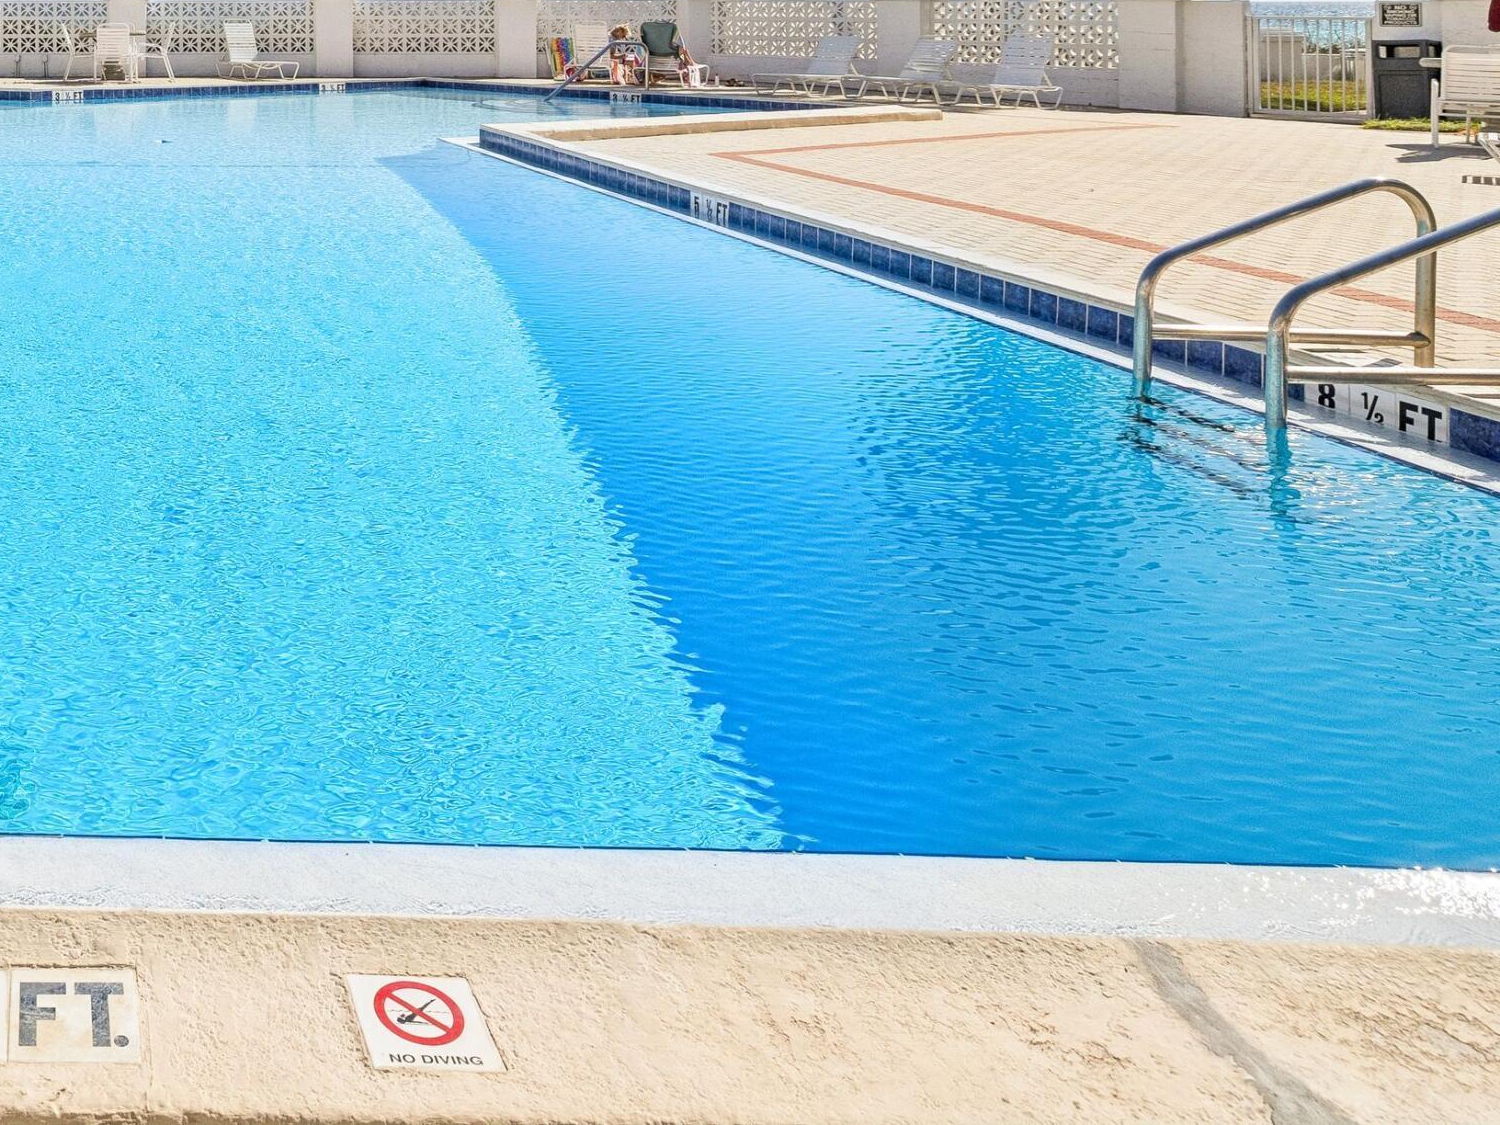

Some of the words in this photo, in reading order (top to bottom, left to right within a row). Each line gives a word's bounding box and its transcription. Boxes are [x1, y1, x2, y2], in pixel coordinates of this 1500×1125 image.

[716, 202, 728, 226] FT
[1318, 383, 1336, 409] 8
[18, 982, 129, 1048] FT.
[389, 1053, 416, 1064] NO
[421, 1053, 484, 1066] DIVING
